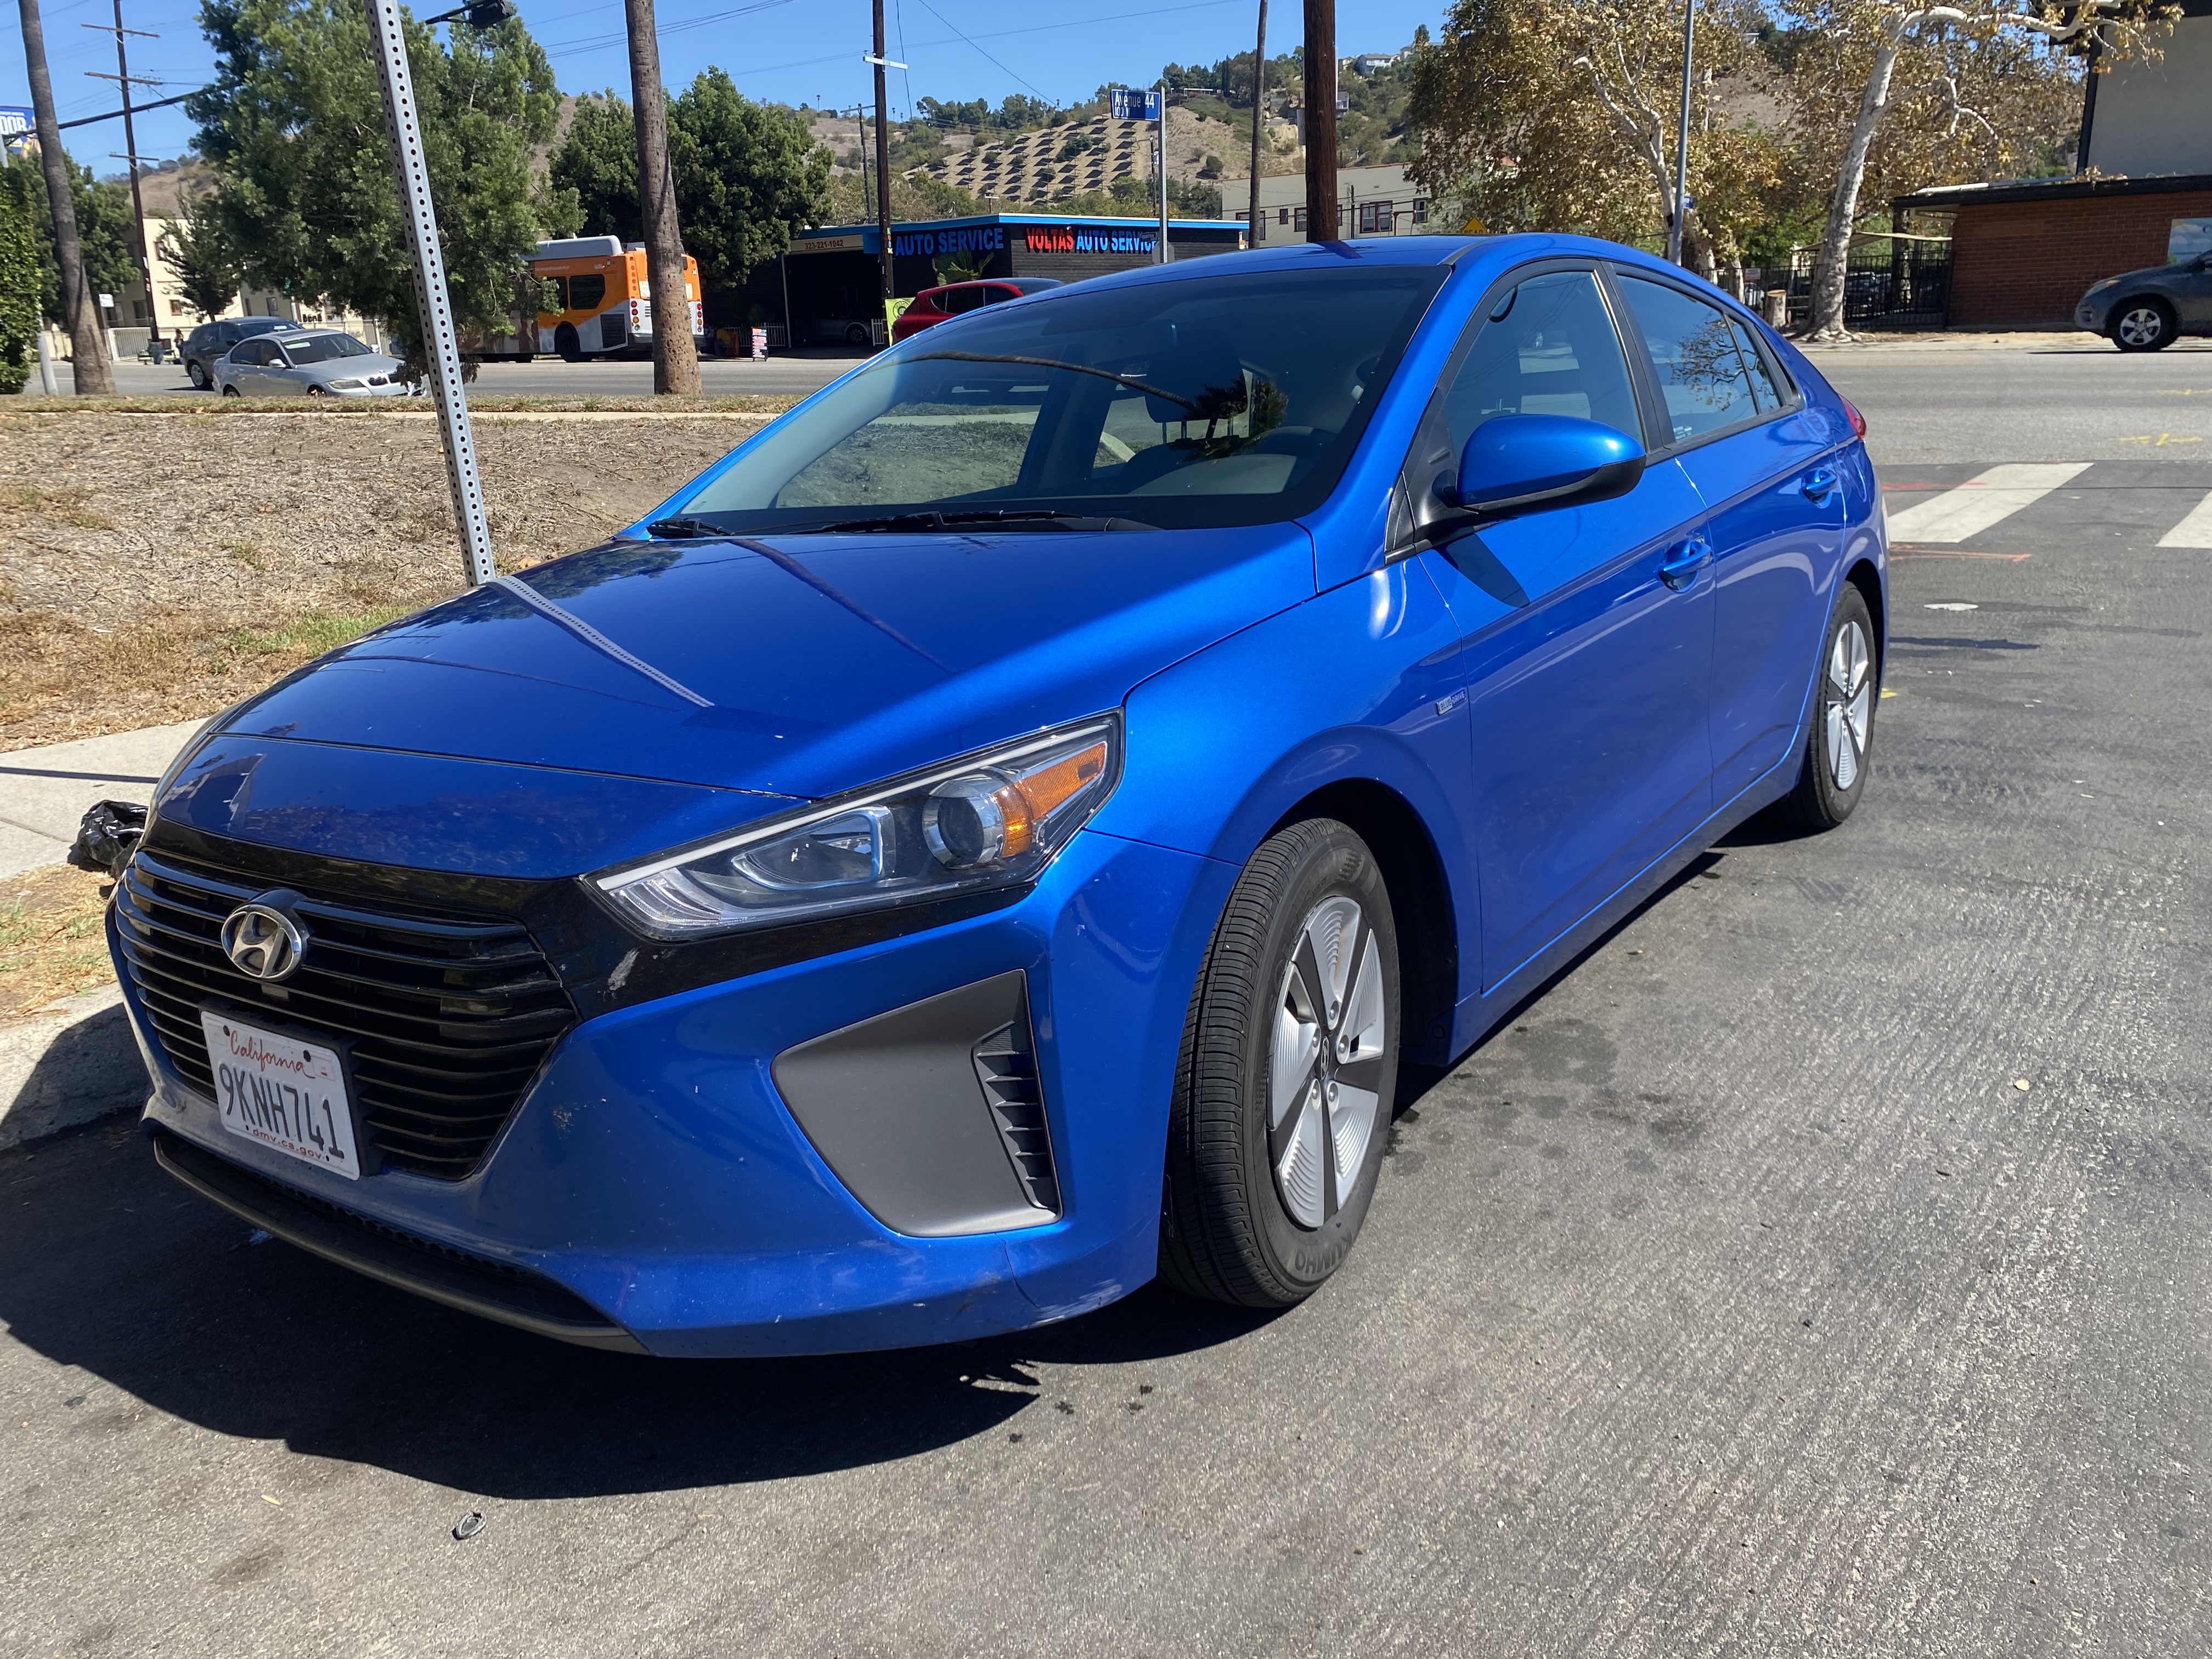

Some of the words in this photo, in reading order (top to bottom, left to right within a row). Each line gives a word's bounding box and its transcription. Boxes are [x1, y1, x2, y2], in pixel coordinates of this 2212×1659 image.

[1114, 91, 1141, 108] Avenue
[1145, 94, 1155, 109] 44
[1114, 106, 1124, 117] 100
[804, 240, 844, 250] 323-221-1042
[895, 234, 934, 256] AUTO
[938, 228, 1004, 253] SERVICE
[1026, 228, 1074, 250] VOLTAS
[1076, 229, 1108, 251] AUTO
[230, 1030, 316, 1079] California
[219, 1063, 345, 1159] 9KNH741
[252, 1128, 322, 1160] dmv.ca.gov
[1295, 1229, 1353, 1274] KUMHO
